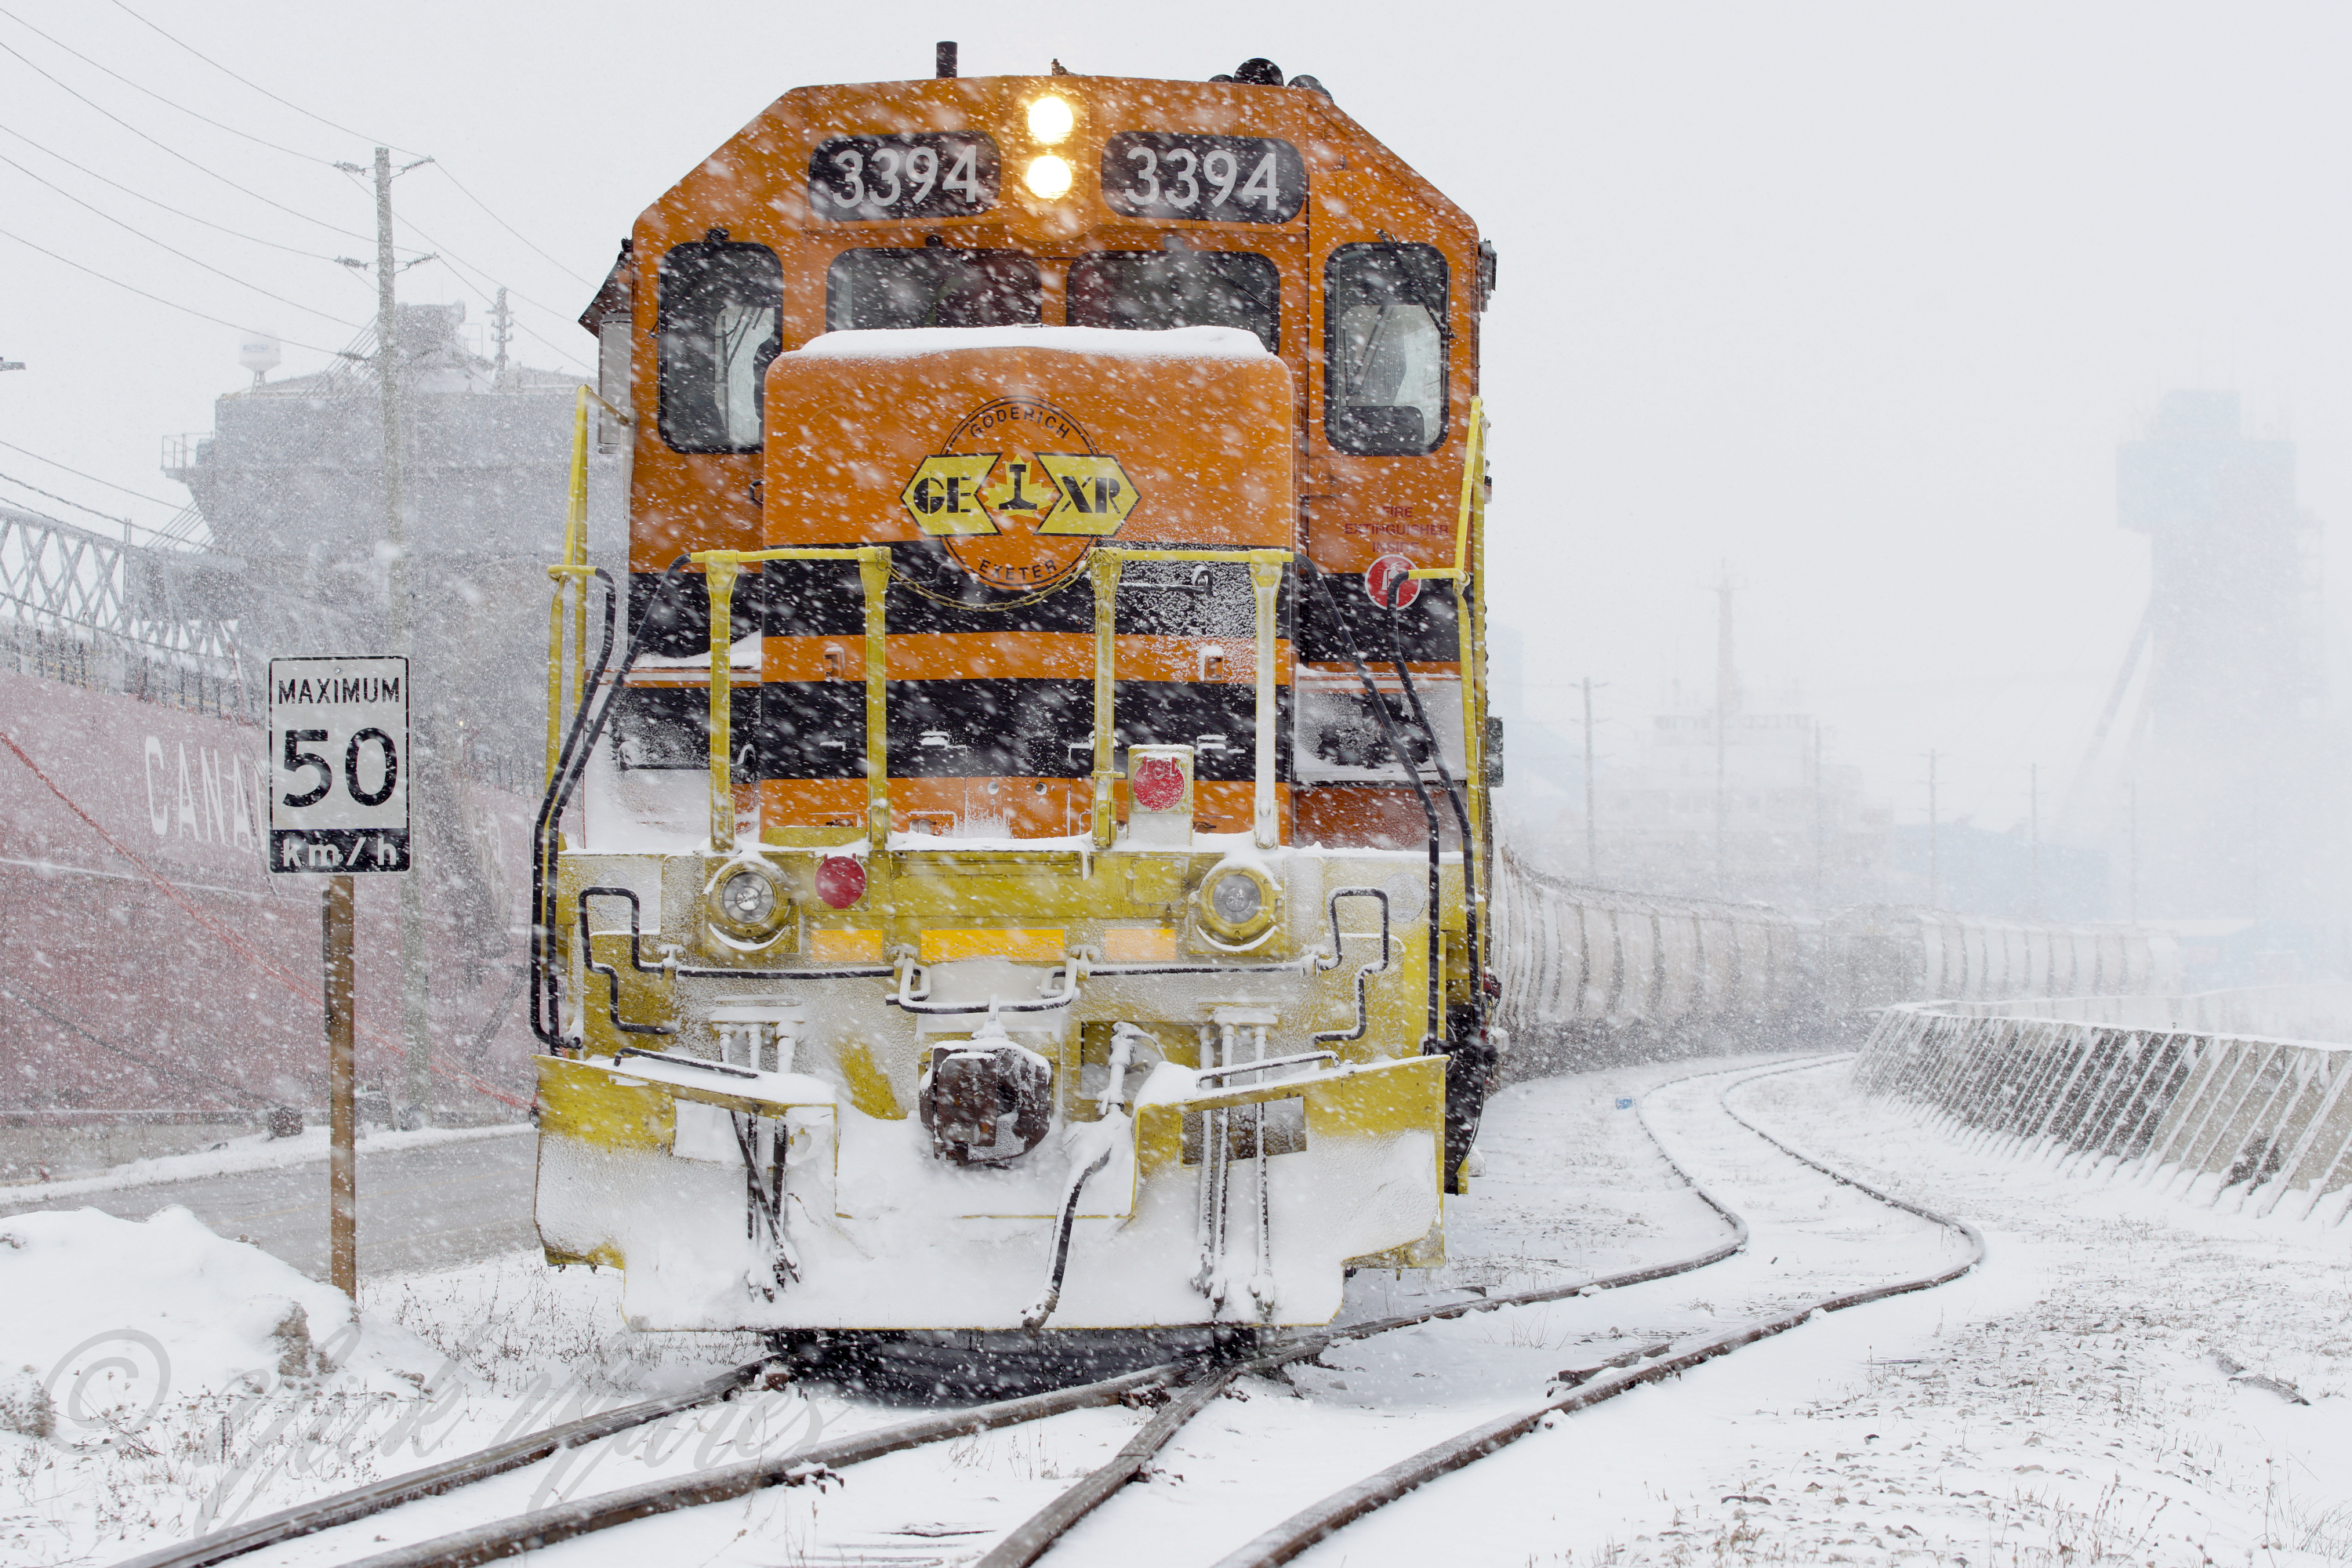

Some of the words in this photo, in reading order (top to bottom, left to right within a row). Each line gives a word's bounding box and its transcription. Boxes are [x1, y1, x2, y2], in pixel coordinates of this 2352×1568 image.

[831, 144, 980, 209] 3394
[1124, 146, 1280, 211] 3394
[970, 406, 1070, 440] GODERICH
[913, 476, 971, 514] GE
[1060, 476, 1121, 514] XR
[1382, 506, 1414, 518] FIRE
[1345, 523, 1449, 535] EXTINGUISHER
[1372, 541, 1420, 553] INSIDE
[978, 558, 1058, 581] EXETER
[278, 677, 400, 704] MAXIMUM
[282, 727, 397, 808] 50
[283, 837, 397, 867] km/h
